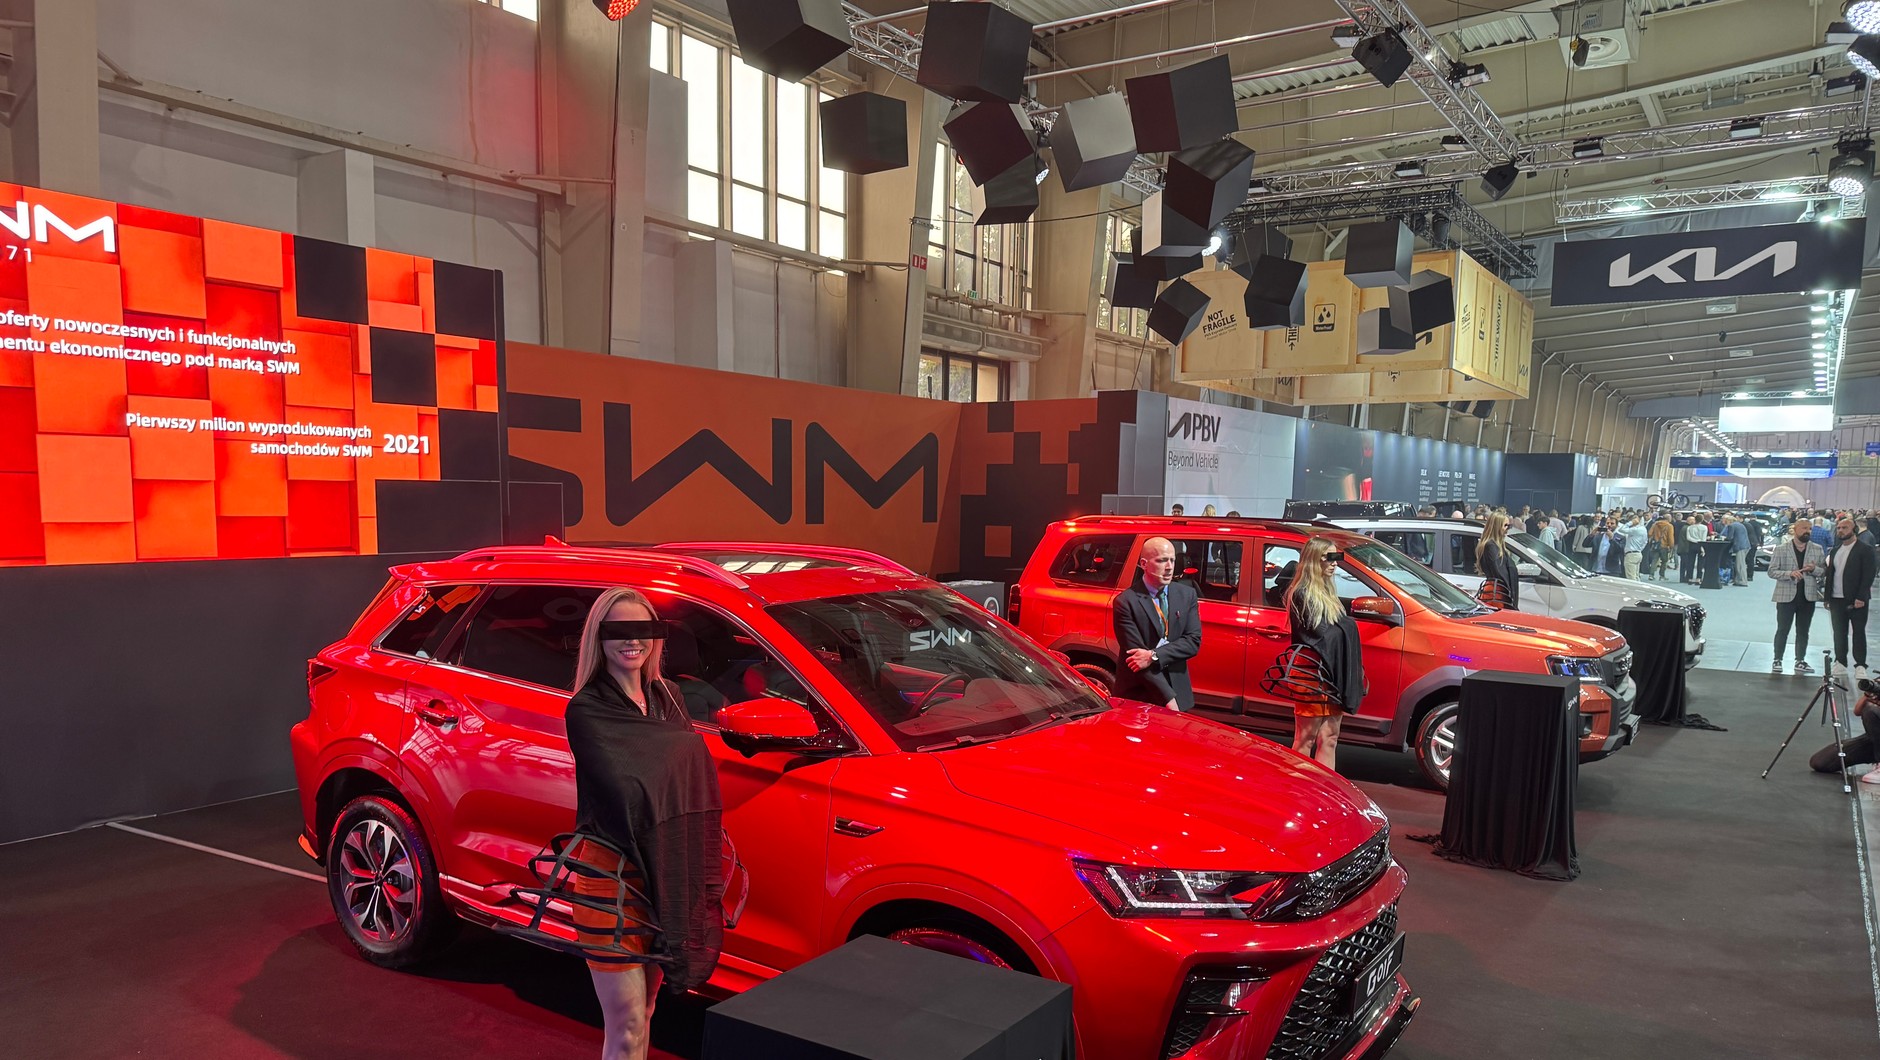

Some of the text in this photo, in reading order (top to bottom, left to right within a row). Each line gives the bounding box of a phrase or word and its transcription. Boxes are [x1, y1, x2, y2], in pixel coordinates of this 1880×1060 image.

[1608, 241, 1797, 287] KIA
[1202, 314, 1237, 334] FRAGILE
[1207, 310, 1224, 323] NOT
[54, 318, 175, 342] nowoczesnych
[179, 328, 184, 342] i
[187, 330, 296, 354] funkcjonalnych
[50, 339, 181, 366] ekonomicznego
[185, 353, 214, 368] pod
[218, 357, 264, 374] marką
[267, 360, 300, 375] SWM
[126, 413, 372, 439] Pierwszy milion wyprodukowanych
[1192, 413, 1221, 443] PBV
[250, 442, 373, 458] samochodów SWM
[383, 434, 430, 454] 2021
[1168, 451, 1219, 470] Beyond Vehicle
[910, 627, 972, 652] SWM
